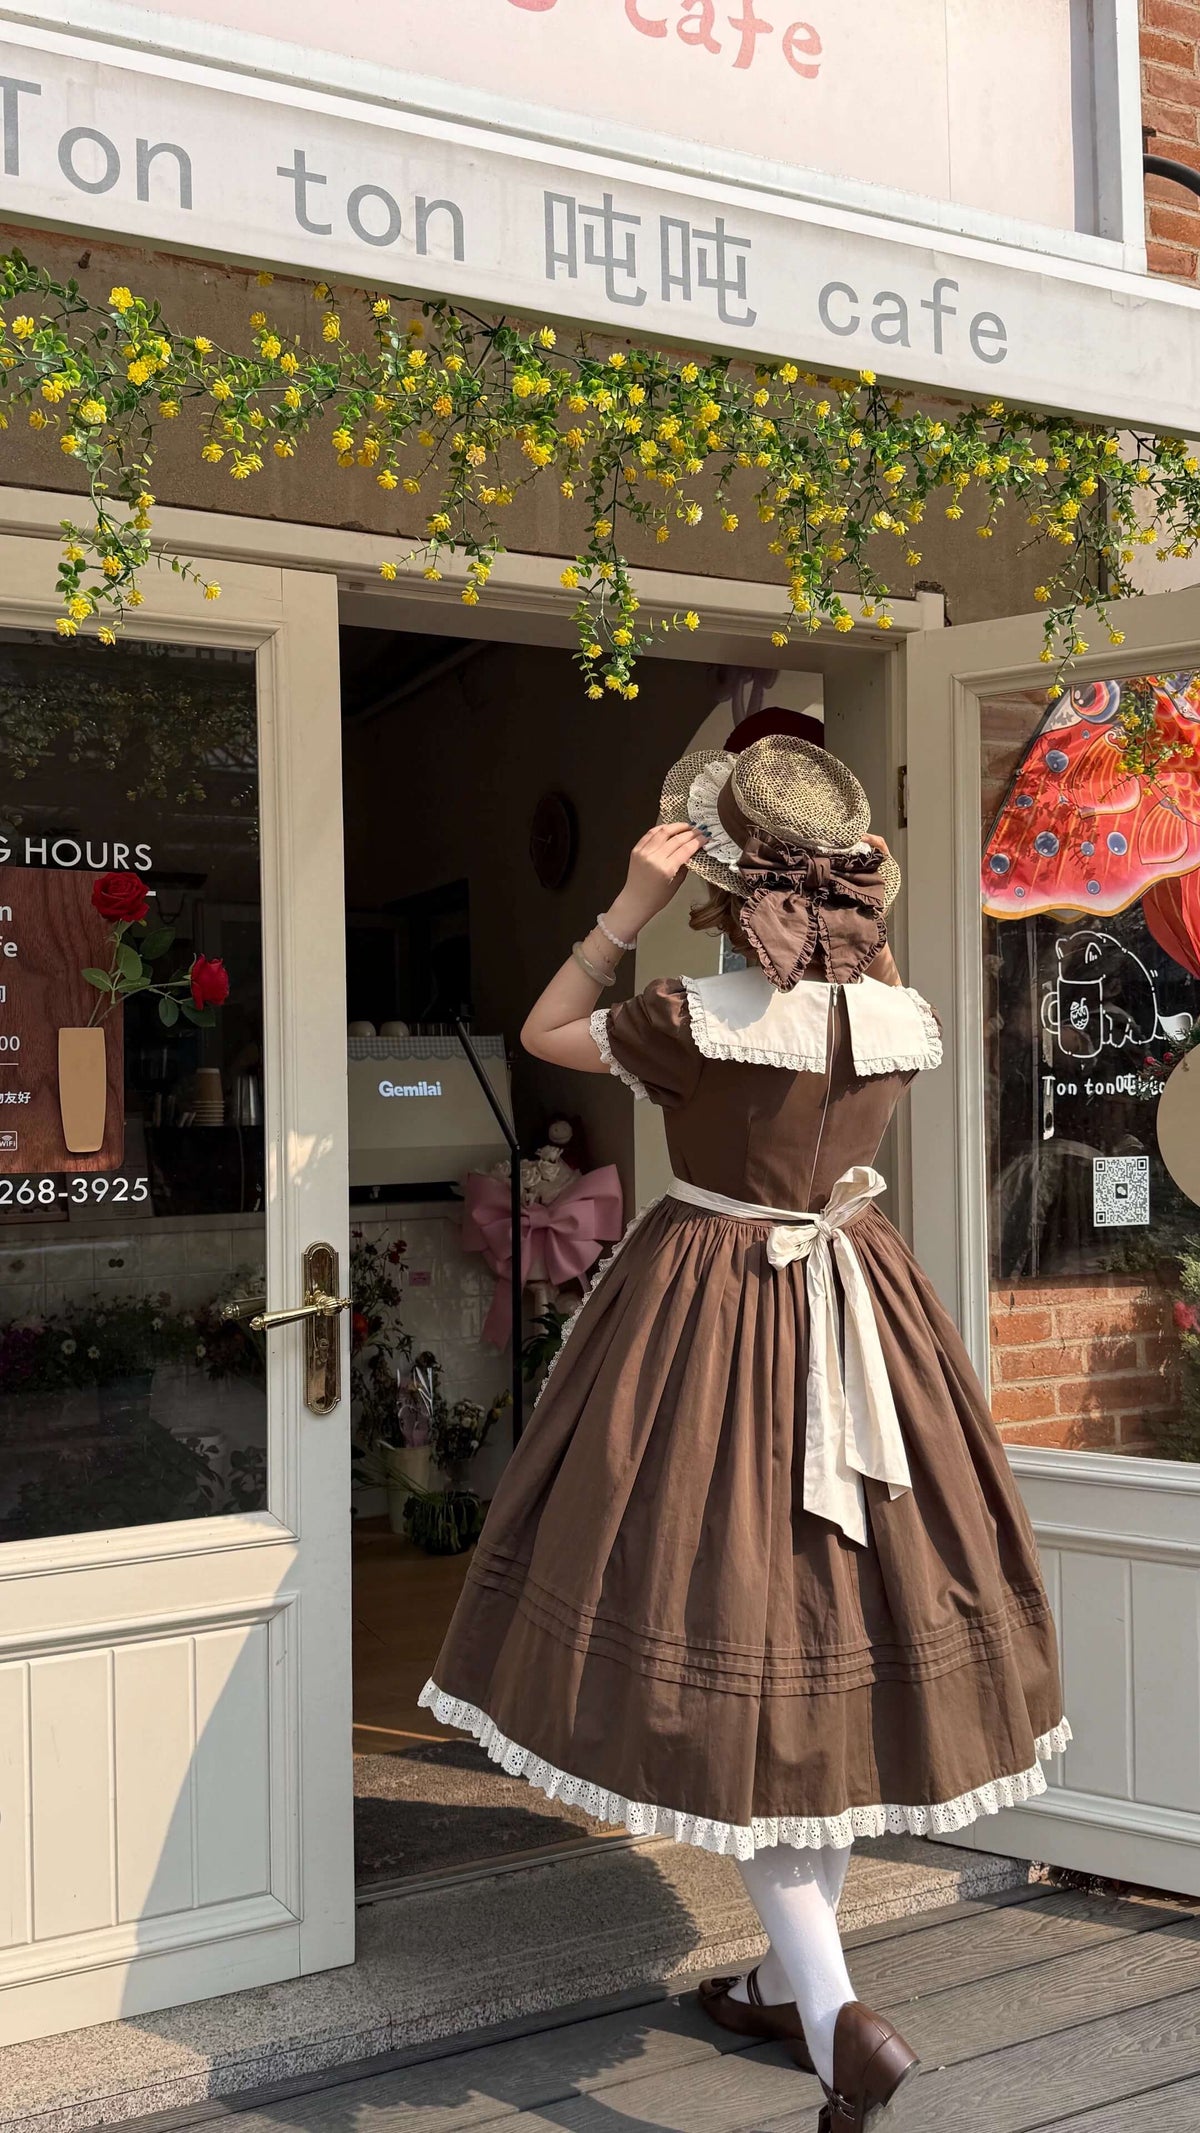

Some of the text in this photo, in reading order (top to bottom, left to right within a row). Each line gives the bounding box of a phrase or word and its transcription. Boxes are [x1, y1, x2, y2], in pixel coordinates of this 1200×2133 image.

[624, 0, 823, 79] cafe
[0, 75, 1008, 364] Ton ton 吨吨 cafe
[25, 837, 152, 871] HOURS
[378, 1080, 442, 1098] Gemilai
[1041, 1075, 1078, 1096] Ton
[0, 1177, 149, 1205] 268-3925
